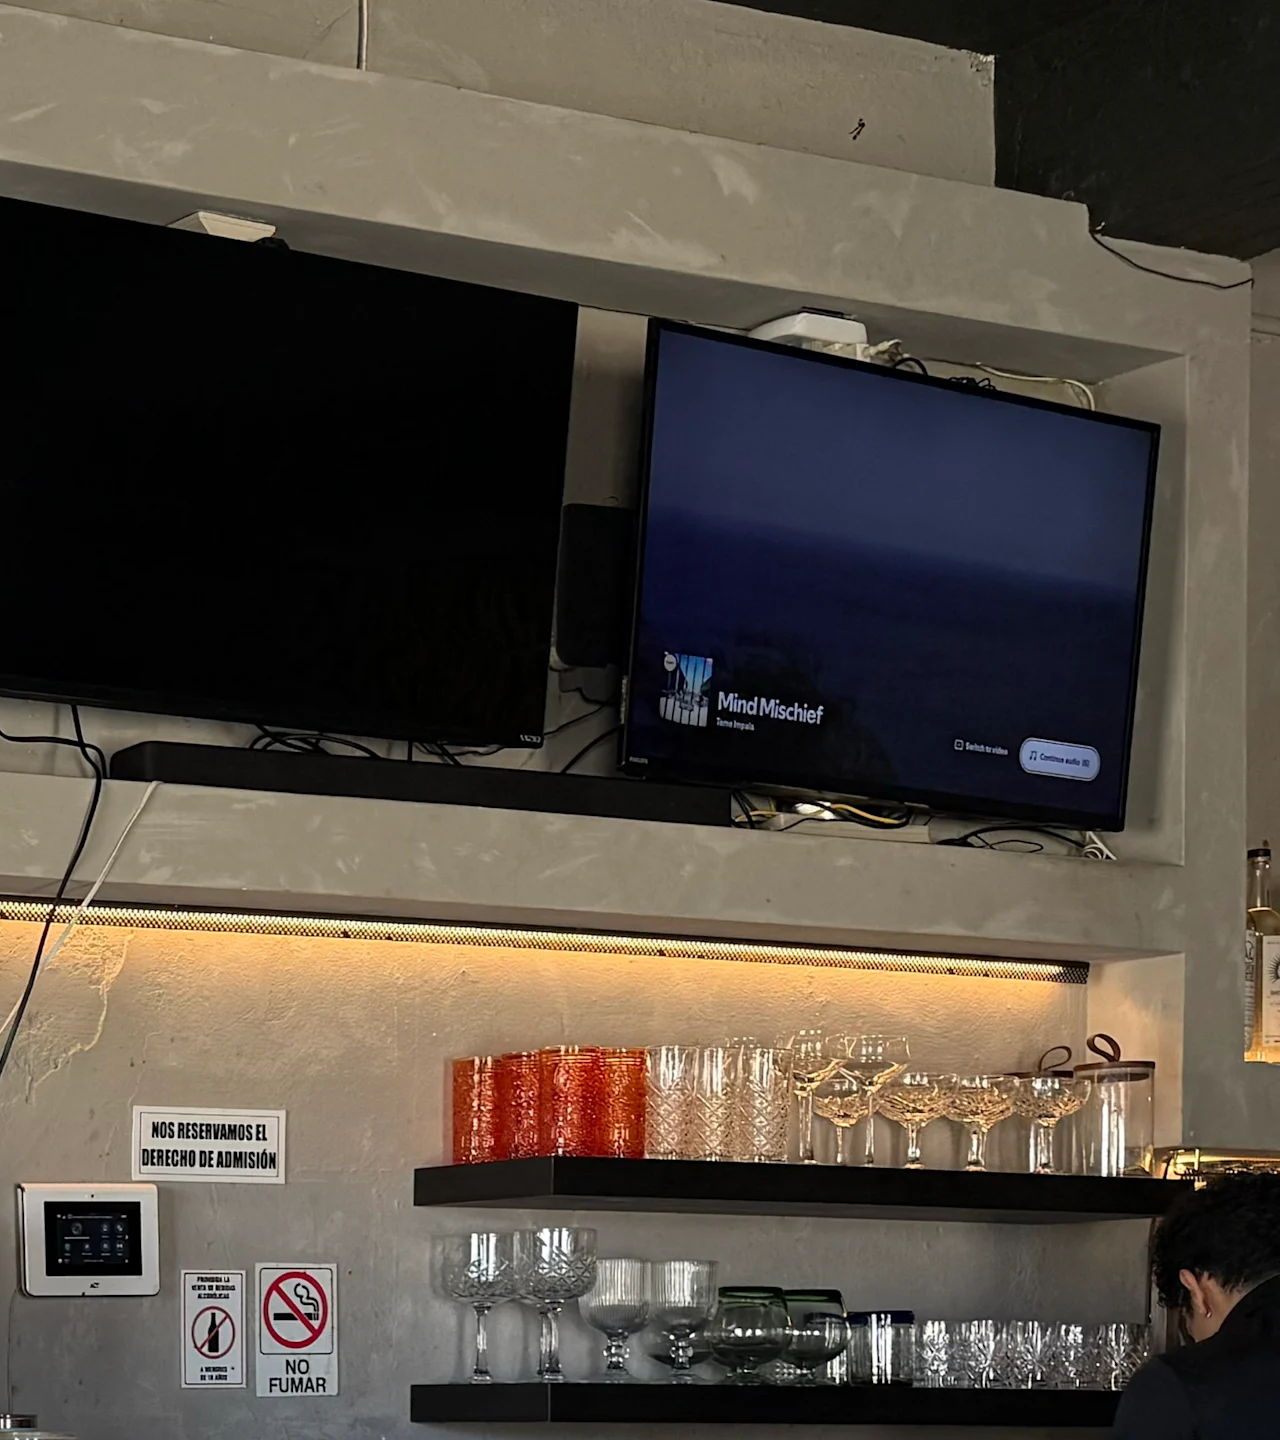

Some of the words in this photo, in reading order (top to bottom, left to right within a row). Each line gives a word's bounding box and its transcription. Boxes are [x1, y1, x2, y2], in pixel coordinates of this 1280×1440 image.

[717, 690, 758, 716] Mind
[759, 697, 824, 725] Mischief
[151, 1121, 175, 1139] NOS
[177, 1122, 253, 1141] RESERVAMOS
[255, 1124, 268, 1141] EL
[141, 1148, 196, 1168] DERECHO
[199, 1150, 214, 1168] DE
[216, 1148, 277, 1170] ADMISIÓN
[285, 1359, 310, 1375] NO
[268, 1377, 327, 1394] FUMAR
